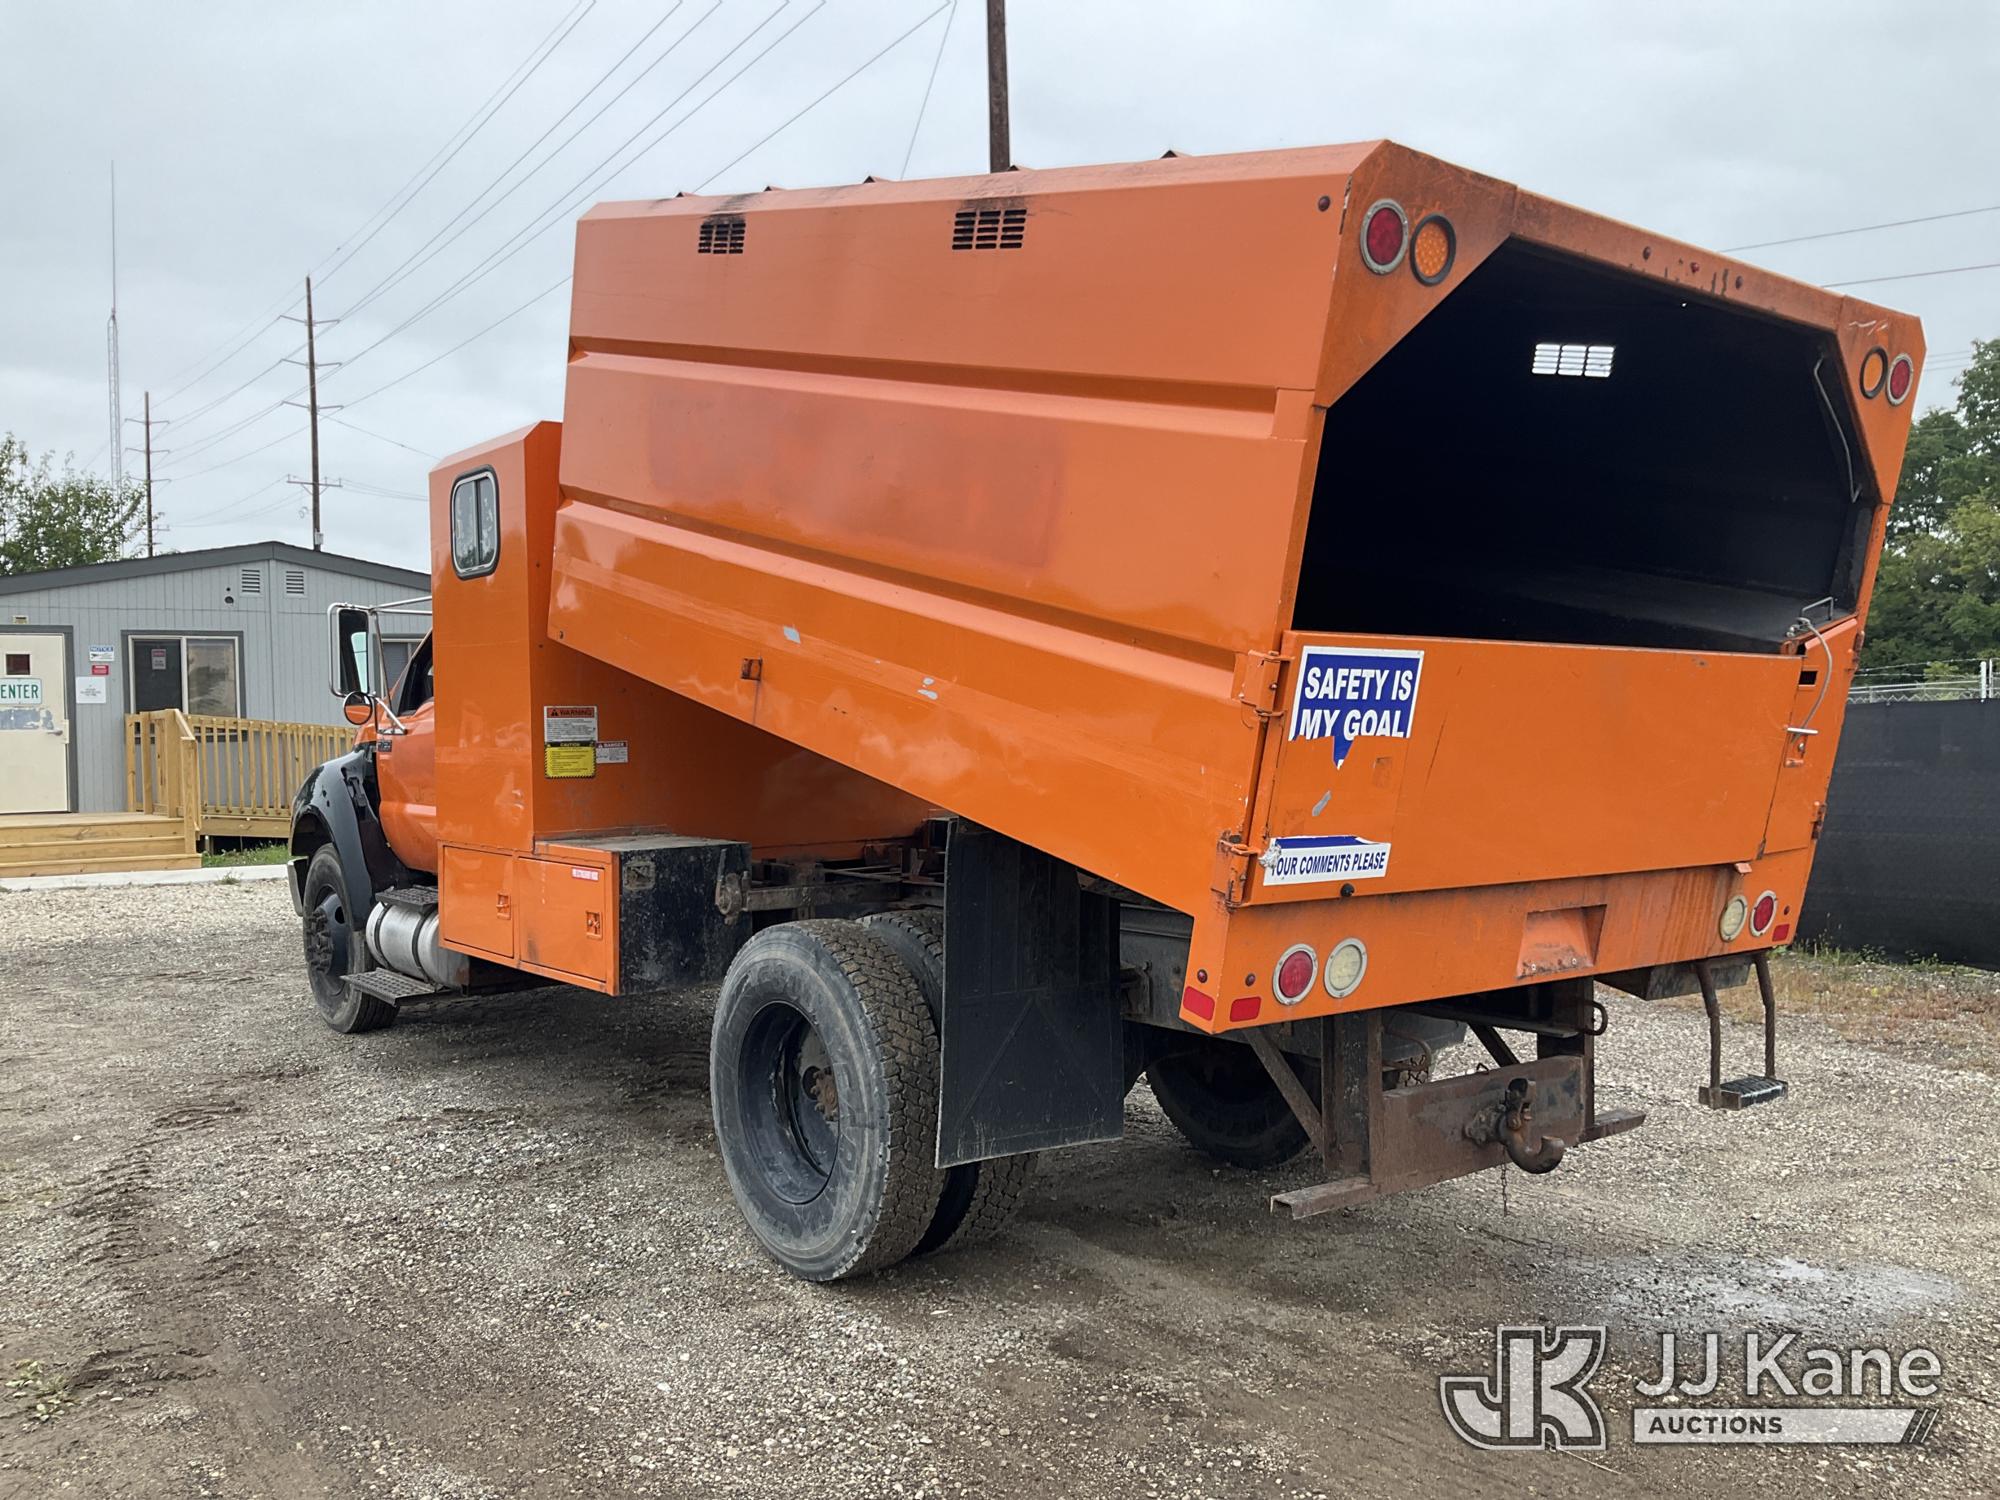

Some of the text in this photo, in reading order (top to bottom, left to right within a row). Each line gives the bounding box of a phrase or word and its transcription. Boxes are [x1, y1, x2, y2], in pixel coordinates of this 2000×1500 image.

[1, 684, 39, 699] ENTER
[1304, 667, 1413, 701] SAFETY IS
[1299, 709, 1404, 741] MY GOAL
[1299, 853, 1351, 875] COMMENTS
[1351, 852, 1386, 871] PLEASE
